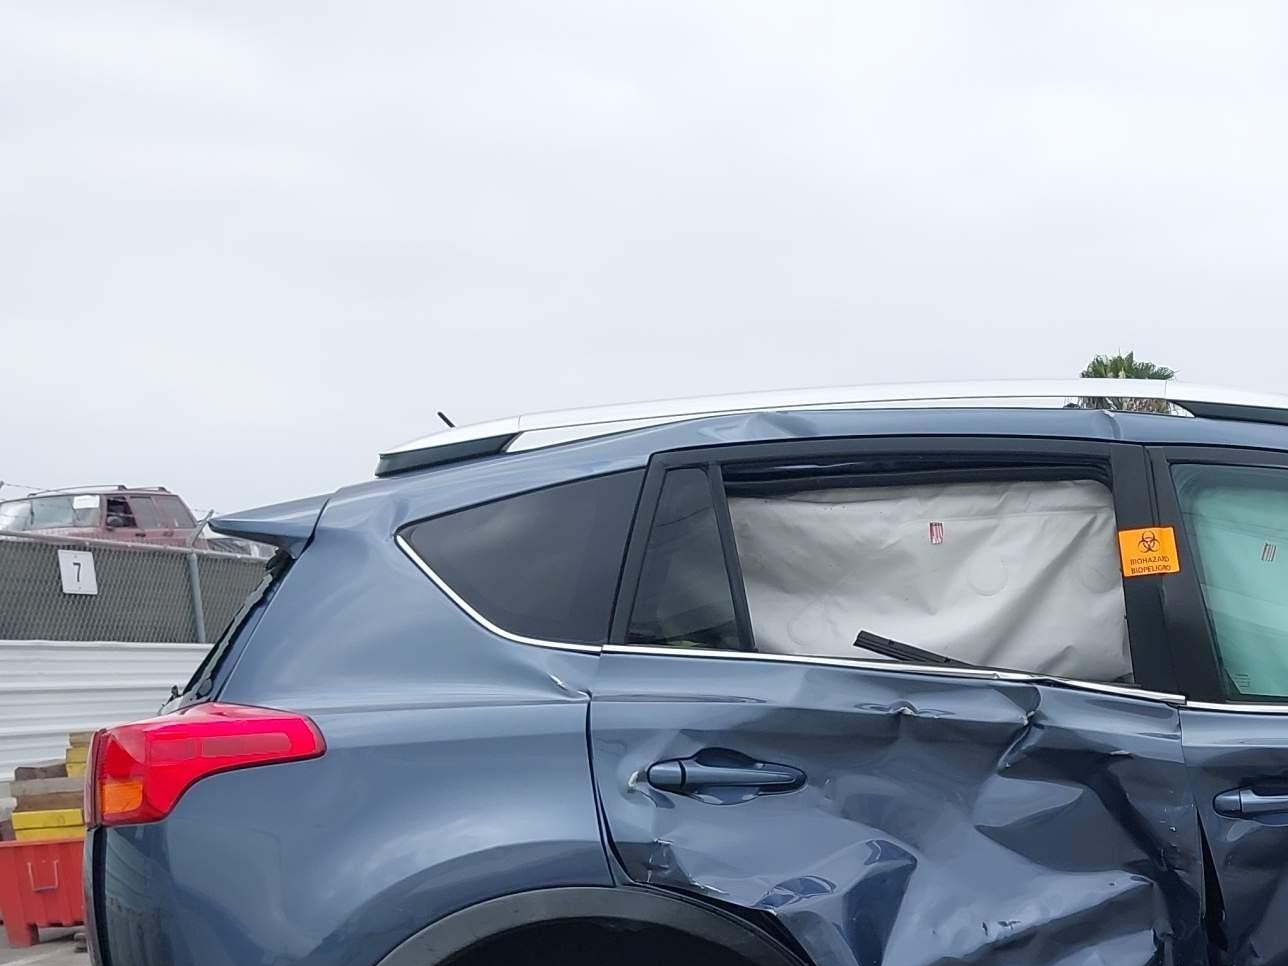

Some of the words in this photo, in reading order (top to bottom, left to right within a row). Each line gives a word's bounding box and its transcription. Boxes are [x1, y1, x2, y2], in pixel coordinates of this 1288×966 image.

[1130, 556, 1170, 566] BIOHAZARD
[72, 562, 81, 583] 7
[1131, 564, 1171, 574] BIOPELIGRO
